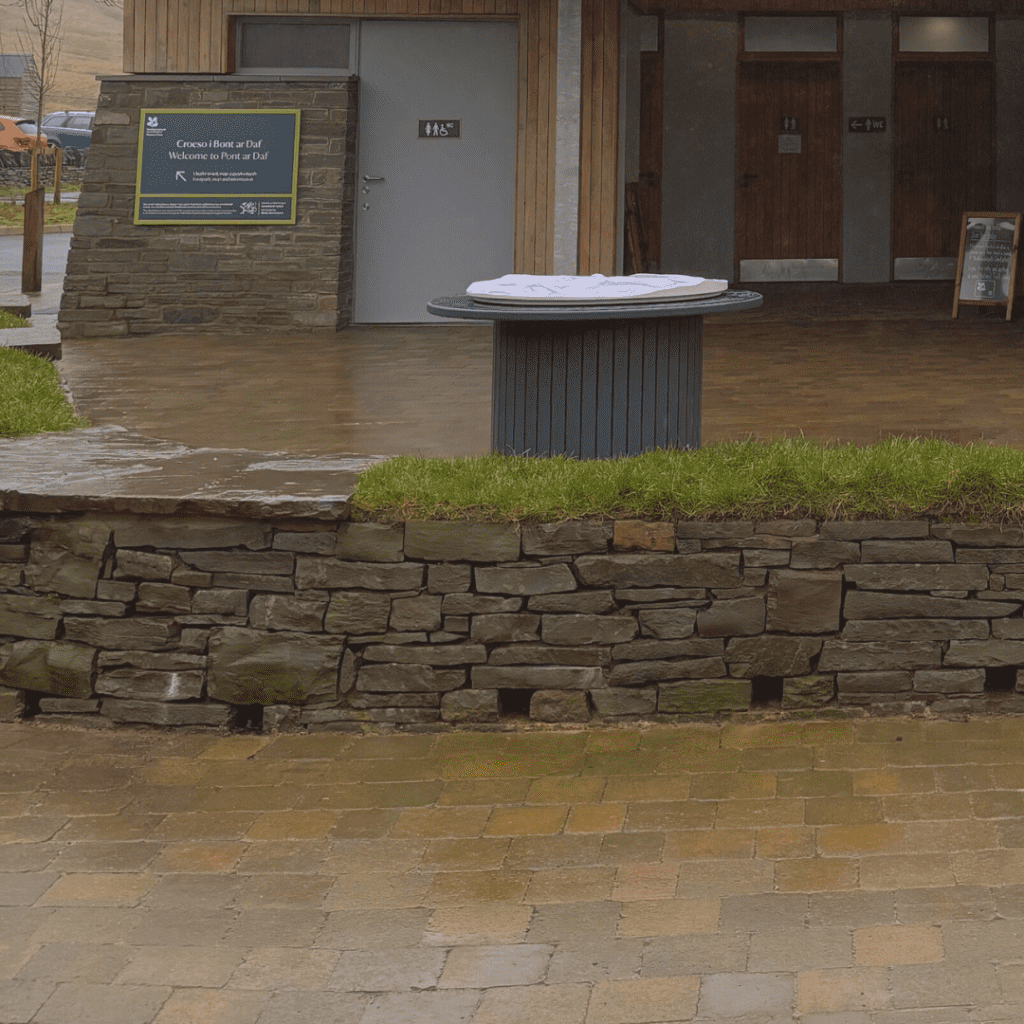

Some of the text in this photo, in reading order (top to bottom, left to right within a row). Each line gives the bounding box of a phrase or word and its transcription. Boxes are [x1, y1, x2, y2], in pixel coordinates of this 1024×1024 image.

[872, 120, 884, 128] WC
[176, 139, 208, 148] Croeso
[213, 139, 234, 148] Bont
[246, 139, 263, 148] Daf
[168, 151, 208, 160] Welcome
[210, 152, 219, 160] to
[221, 151, 240, 160] Pont
[252, 151, 269, 160] Daf
